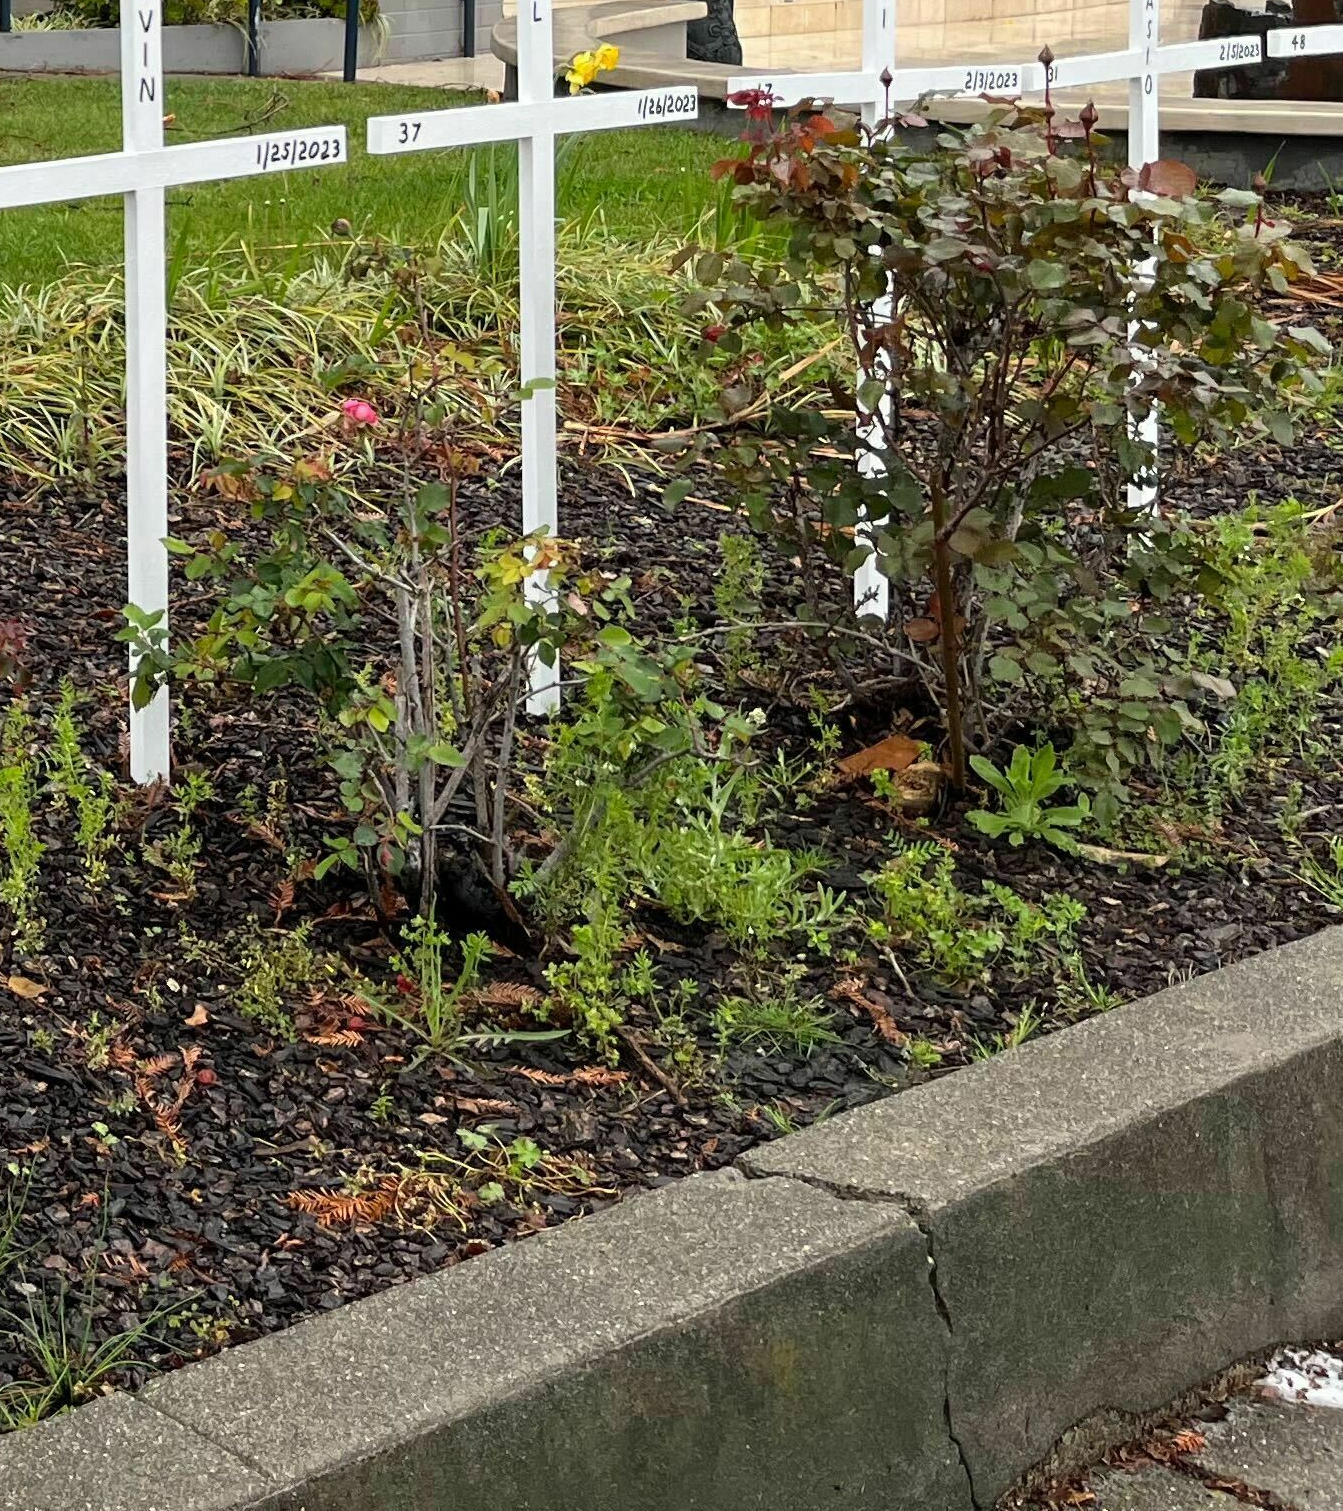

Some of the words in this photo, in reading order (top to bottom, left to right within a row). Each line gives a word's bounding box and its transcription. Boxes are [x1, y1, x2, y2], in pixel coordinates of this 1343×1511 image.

[1291, 34, 1306, 51] 48
[964, 71, 1018, 91] 2/3/2023
[637, 94, 696, 118] 1/26/2023
[398, 122, 421, 144] 37
[256, 139, 340, 169] 1/25/2023
